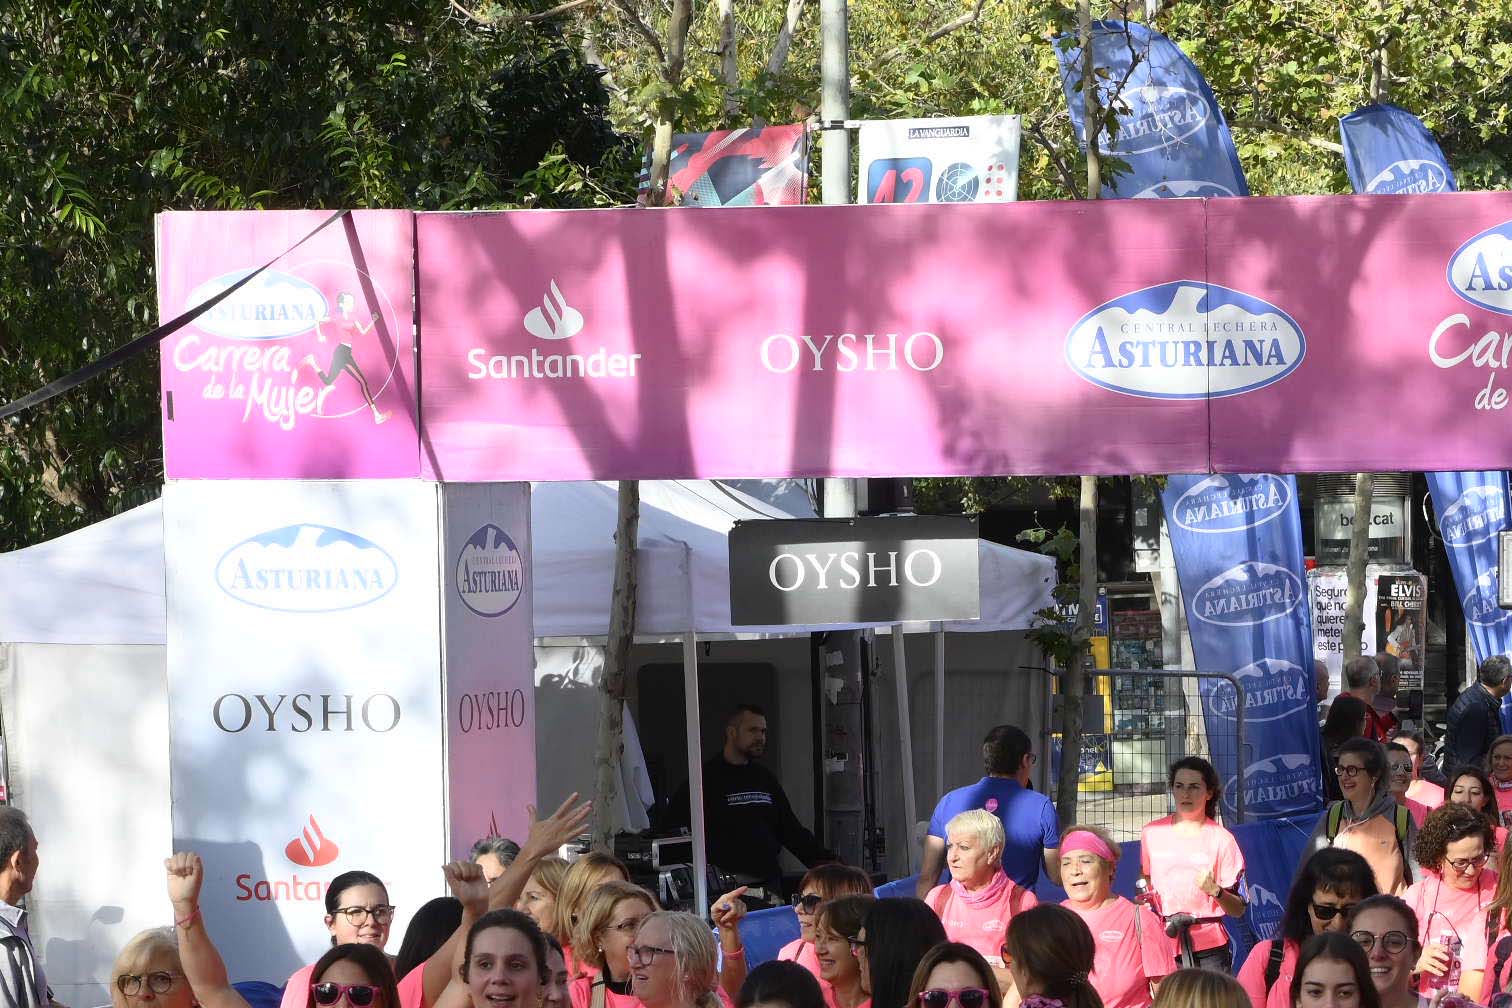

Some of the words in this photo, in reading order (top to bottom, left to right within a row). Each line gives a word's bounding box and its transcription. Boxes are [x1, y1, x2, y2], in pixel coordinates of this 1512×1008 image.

[910, 129, 919, 138] LA
[920, 127, 969, 138] VANGUARDIA
[1120, 321, 1194, 335] CENTRAL
[1203, 320, 1279, 333] LECHERA
[174, 334, 291, 373] Carrera
[468, 347, 642, 379] Santander
[760, 331, 944, 374] OYSHO
[1084, 325, 1287, 369] ASTURIANA
[203, 375, 224, 400] de
[229, 373, 245, 400] la
[242, 369, 336, 431] Mujer
[1474, 374, 1509, 410] de
[231, 557, 384, 591] ASTURIANA
[462, 565, 519, 595] ASTURIANA
[769, 549, 942, 592] OYSHO
[1316, 602, 1333, 614] que
[1391, 584, 1422, 597] ELVIS
[1318, 641, 1336, 651] este
[213, 693, 401, 733] OYSHO
[459, 688, 525, 733] OYSHO
